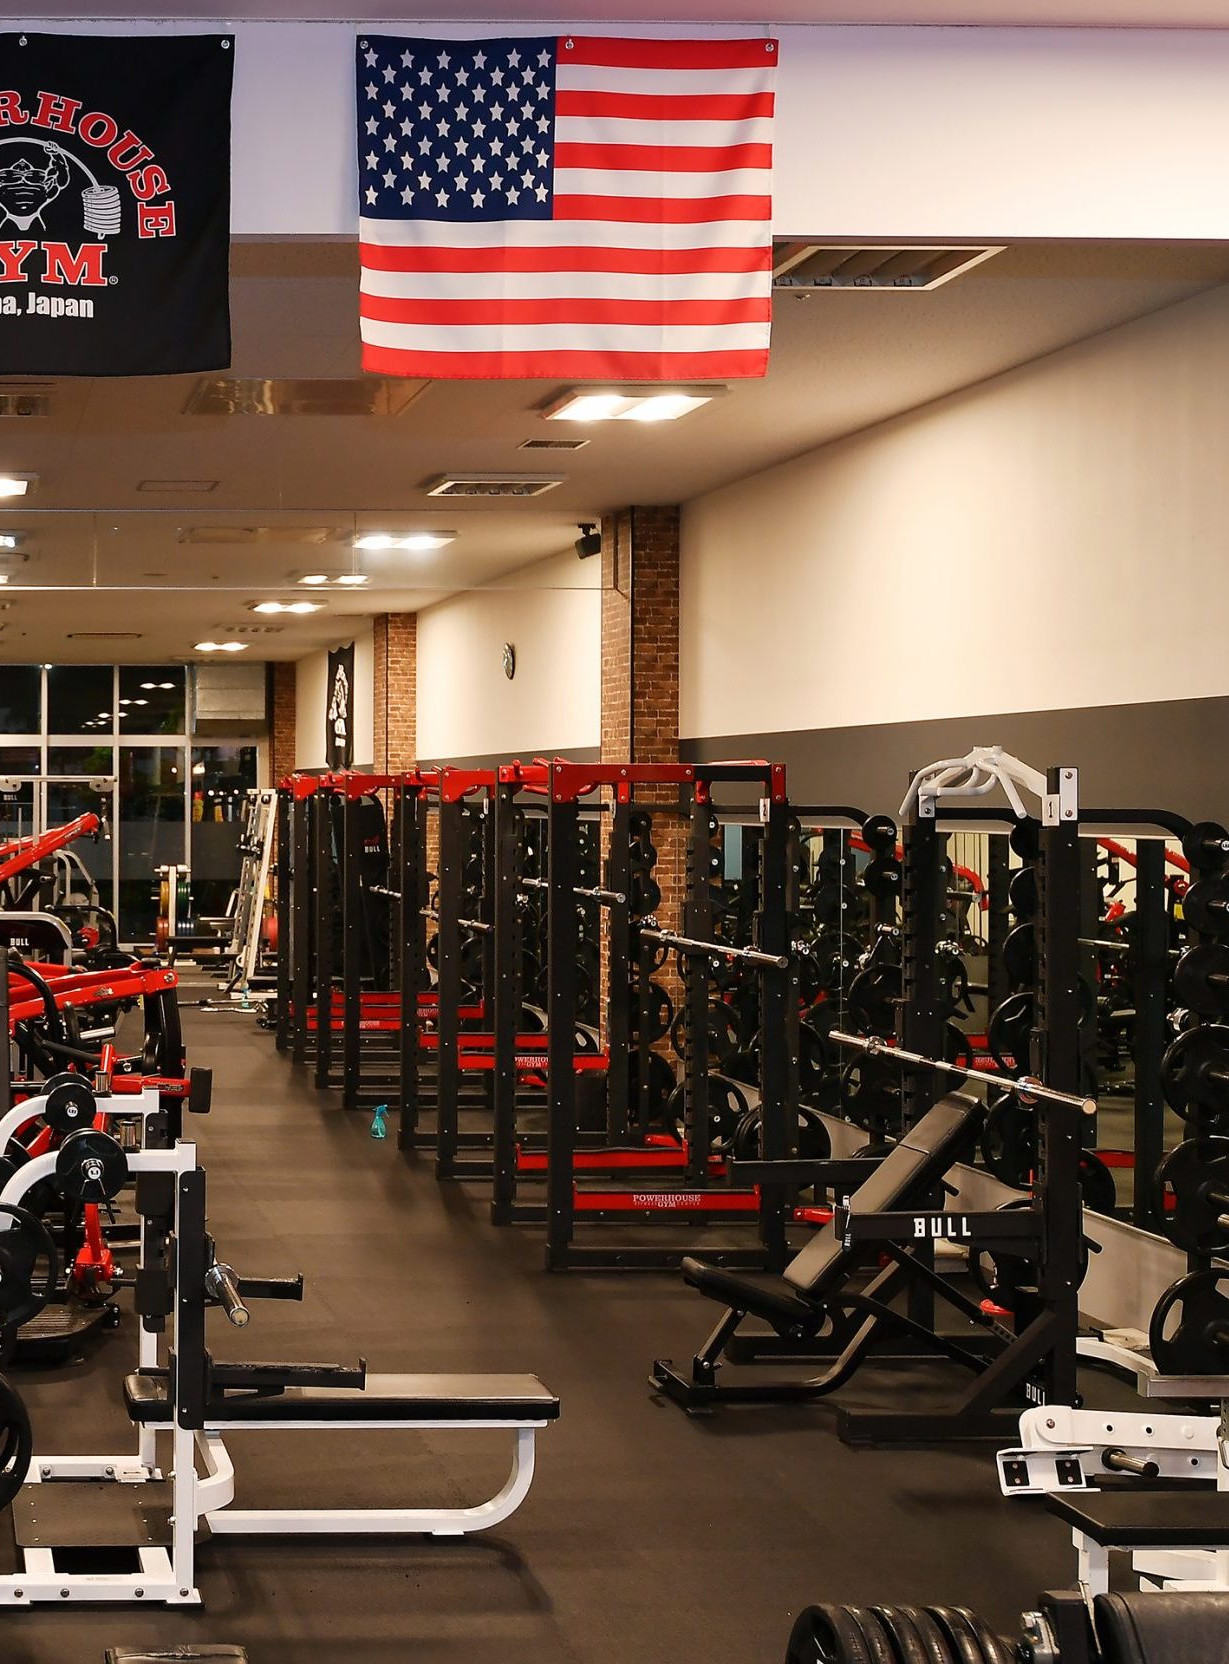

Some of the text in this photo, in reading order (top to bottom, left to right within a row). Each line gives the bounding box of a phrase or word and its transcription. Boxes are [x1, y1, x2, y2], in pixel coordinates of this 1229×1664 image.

[26, 292, 94, 318] Japan
[10, 937, 30, 947] BULL
[632, 1194, 702, 1202] POWERHOUSE
[914, 1217, 972, 1238] BULL
